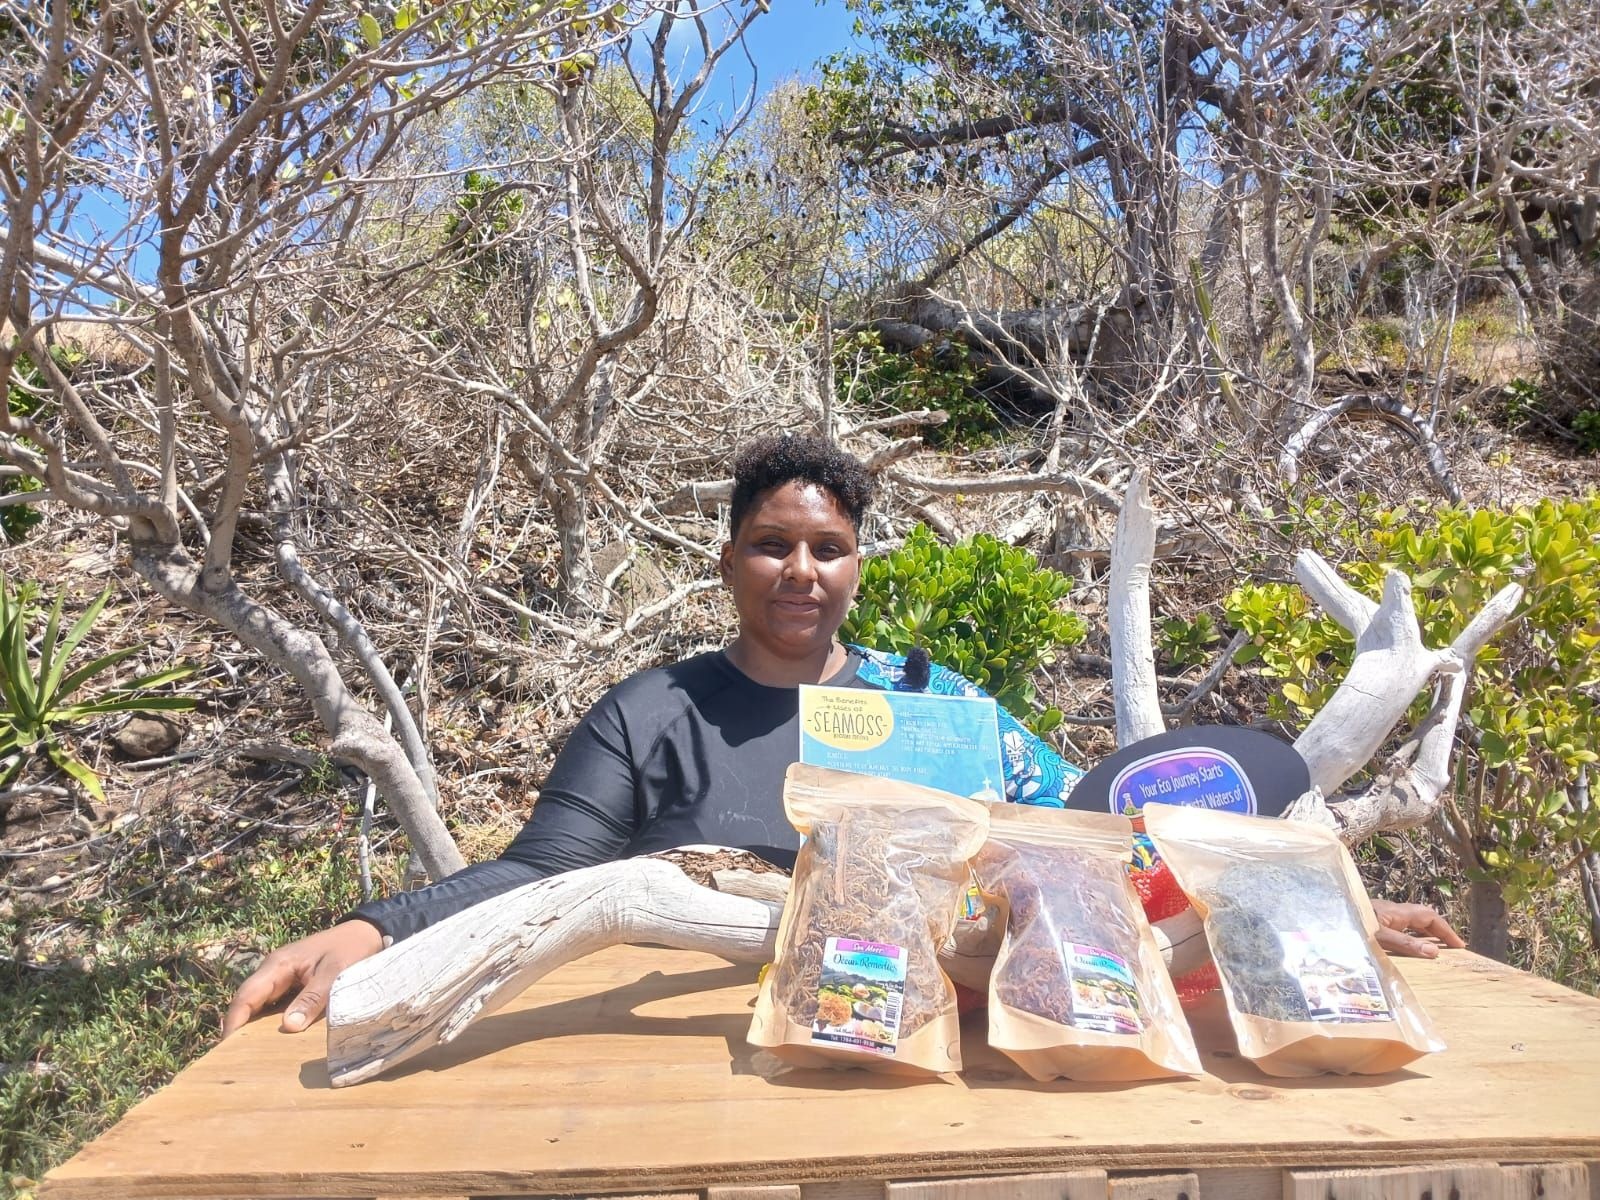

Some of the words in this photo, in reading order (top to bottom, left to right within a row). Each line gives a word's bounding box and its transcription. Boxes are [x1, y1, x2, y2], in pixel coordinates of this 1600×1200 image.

[1139, 783, 1158, 798] Your
[1157, 779, 1171, 793] Eco
[1171, 772, 1201, 790] Journey
[1199, 764, 1223, 781] Starts
[1206, 791, 1234, 807] Waters
[1234, 785, 1242, 800] of
